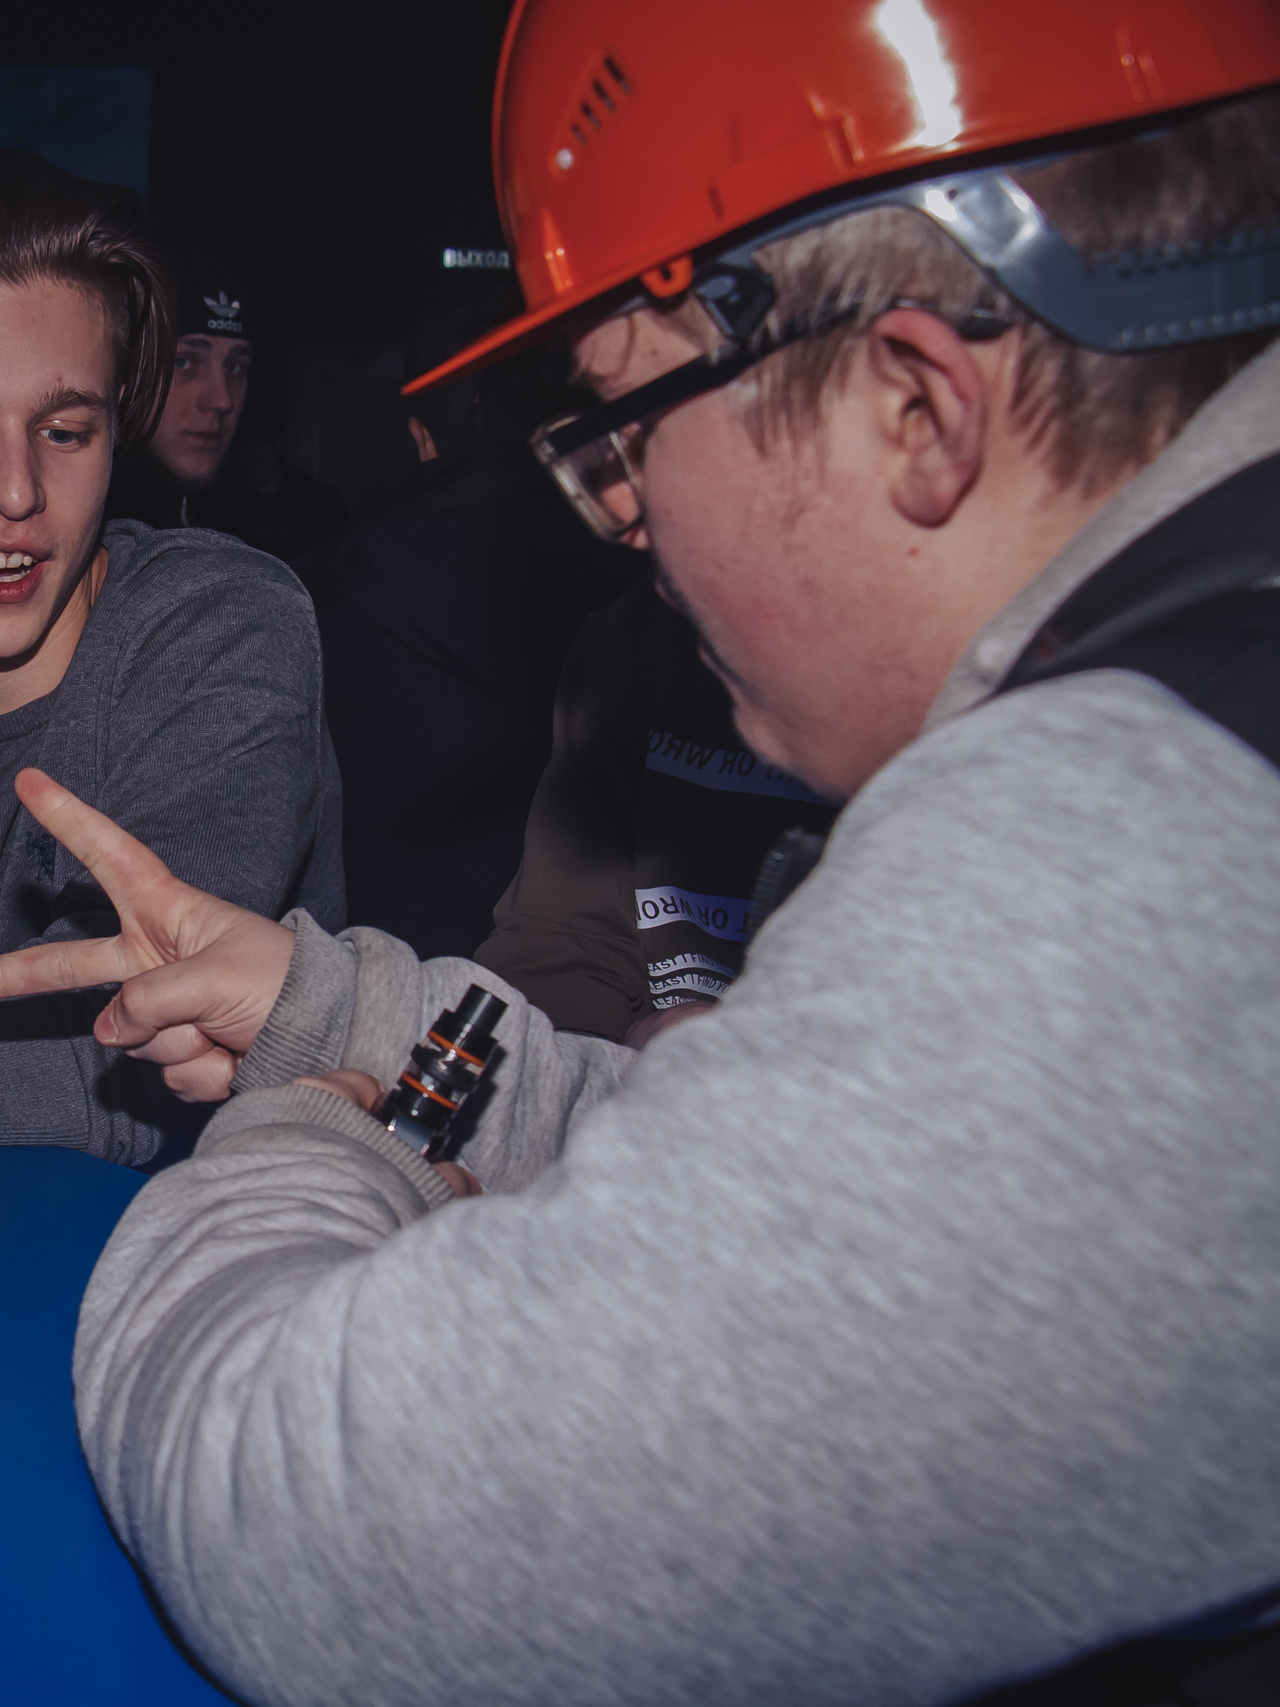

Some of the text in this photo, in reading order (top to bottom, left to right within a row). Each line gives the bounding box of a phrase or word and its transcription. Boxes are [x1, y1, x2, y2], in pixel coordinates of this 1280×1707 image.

[443, 248, 510, 270] ВЫХОД
[207, 318, 243, 333] adidas
[696, 904, 728, 930] OR
